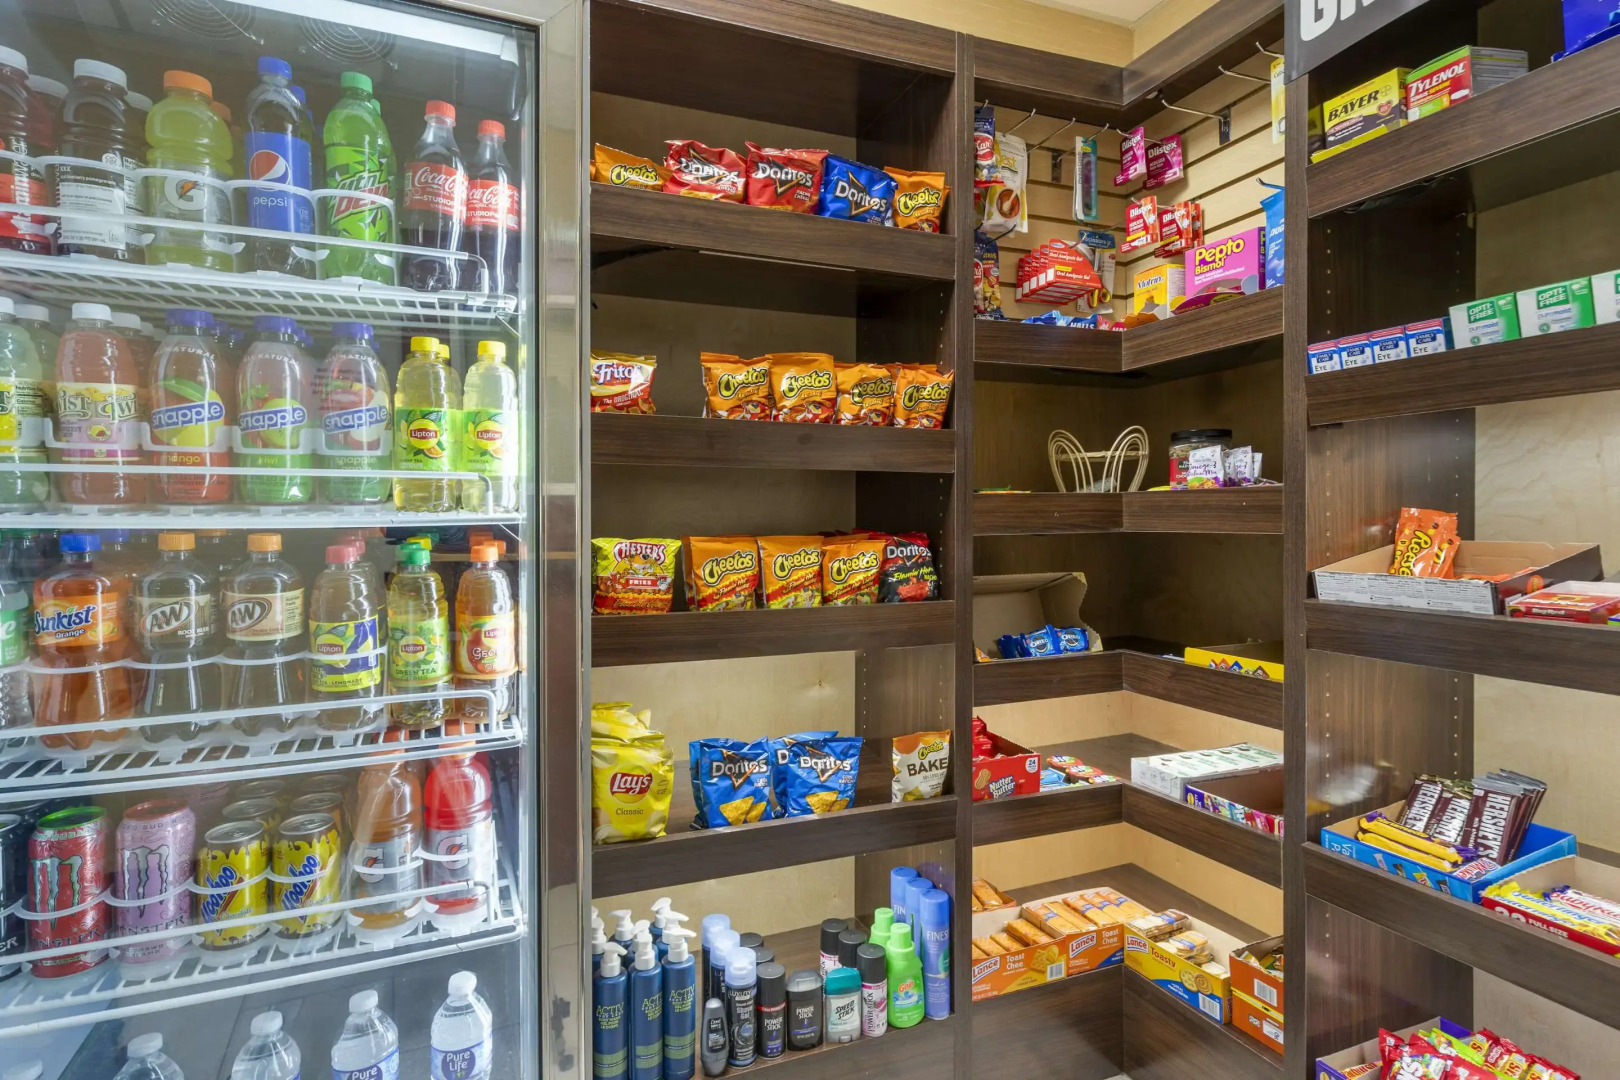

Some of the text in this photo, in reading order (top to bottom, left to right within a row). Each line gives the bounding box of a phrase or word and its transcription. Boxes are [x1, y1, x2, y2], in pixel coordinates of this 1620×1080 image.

[1409, 61, 1467, 98] TYLENOL
[1327, 89, 1380, 122] BAYER
[1122, 134, 1141, 151] Blistex
[1148, 141, 1178, 158] Blistex
[611, 164, 659, 186] Cheetos
[679, 157, 740, 183] Doritos
[753, 162, 813, 187] Doritos
[253, 196, 288, 208] pepsi
[836, 182, 887, 212] Doritos
[897, 188, 942, 215] Cheetos
[1129, 203, 1153, 218] Blistex
[1162, 208, 1186, 221] Blistex
[1195, 238, 1245, 267] Pepto
[1195, 257, 1225, 275] Bismol
[1137, 276, 1162, 289] Motrin
[1538, 287, 1565, 300] OPTI-
[1539, 293, 1567, 307] FREE
[1469, 303, 1493, 315] OPTI-
[1470, 309, 1495, 322] FREE
[1413, 347, 1428, 355] EYE
[718, 367, 768, 399] Cheetos
[782, 370, 833, 400] Cheetos
[851, 377, 893, 405] Cheetos
[902, 383, 950, 410] Cheetos
[152, 401, 222, 428] snapple
[238, 406, 304, 430] snapple
[324, 406, 388, 430] snapple
[411, 430, 436, 439] Lipton
[478, 431, 501, 439] Lipton
[163, 454, 201, 464] mango
[613, 541, 667, 564] CHESTER'S
[886, 545, 932, 558] Doritos
[1399, 530, 1432, 577] Reese
[702, 550, 756, 587] Cheetos
[773, 549, 822, 581] Cheetos
[830, 552, 880, 584] Cheetos
[34, 605, 98, 635] Sunkist
[55, 628, 85, 639] Orange
[318, 644, 341, 653] Lipton
[402, 645, 423, 653] Lipton
[1030, 638, 1049, 648] OREO
[421, 667, 437, 675] TEA
[917, 740, 945, 761] Cheetos
[712, 758, 769, 778] Doritos
[800, 756, 852, 771] Doritos
[611, 773, 652, 796] Lay's
[989, 776, 1013, 793] Nutter
[993, 782, 1016, 799] Butter
[615, 807, 644, 816] Classic
[1477, 792, 1512, 859] HERSHEY'S
[1102, 928, 1119, 938] Toast
[1528, 918, 1569, 939] FULL SIZE
[1070, 934, 1096, 953] Lance
[1102, 936, 1118, 945] Chee
[1126, 935, 1148, 949] Lance
[1006, 953, 1025, 963] Toast
[1150, 946, 1176, 968] Toasty
[972, 959, 999, 979] Lance
[1006, 961, 1024, 970] Chee
[736, 1006, 753, 1014] Shave
[796, 1004, 815, 1016] POWER
[835, 999, 855, 1015] SPEED
[837, 1006, 855, 1020] STICK
[764, 1016, 783, 1027] POWER
[798, 1012, 813, 1020] STICK
[766, 1023, 781, 1031] STICK
[446, 1050, 471, 1063] Pure
[351, 1067, 378, 1080] Pure
[449, 1060, 468, 1073] Life
